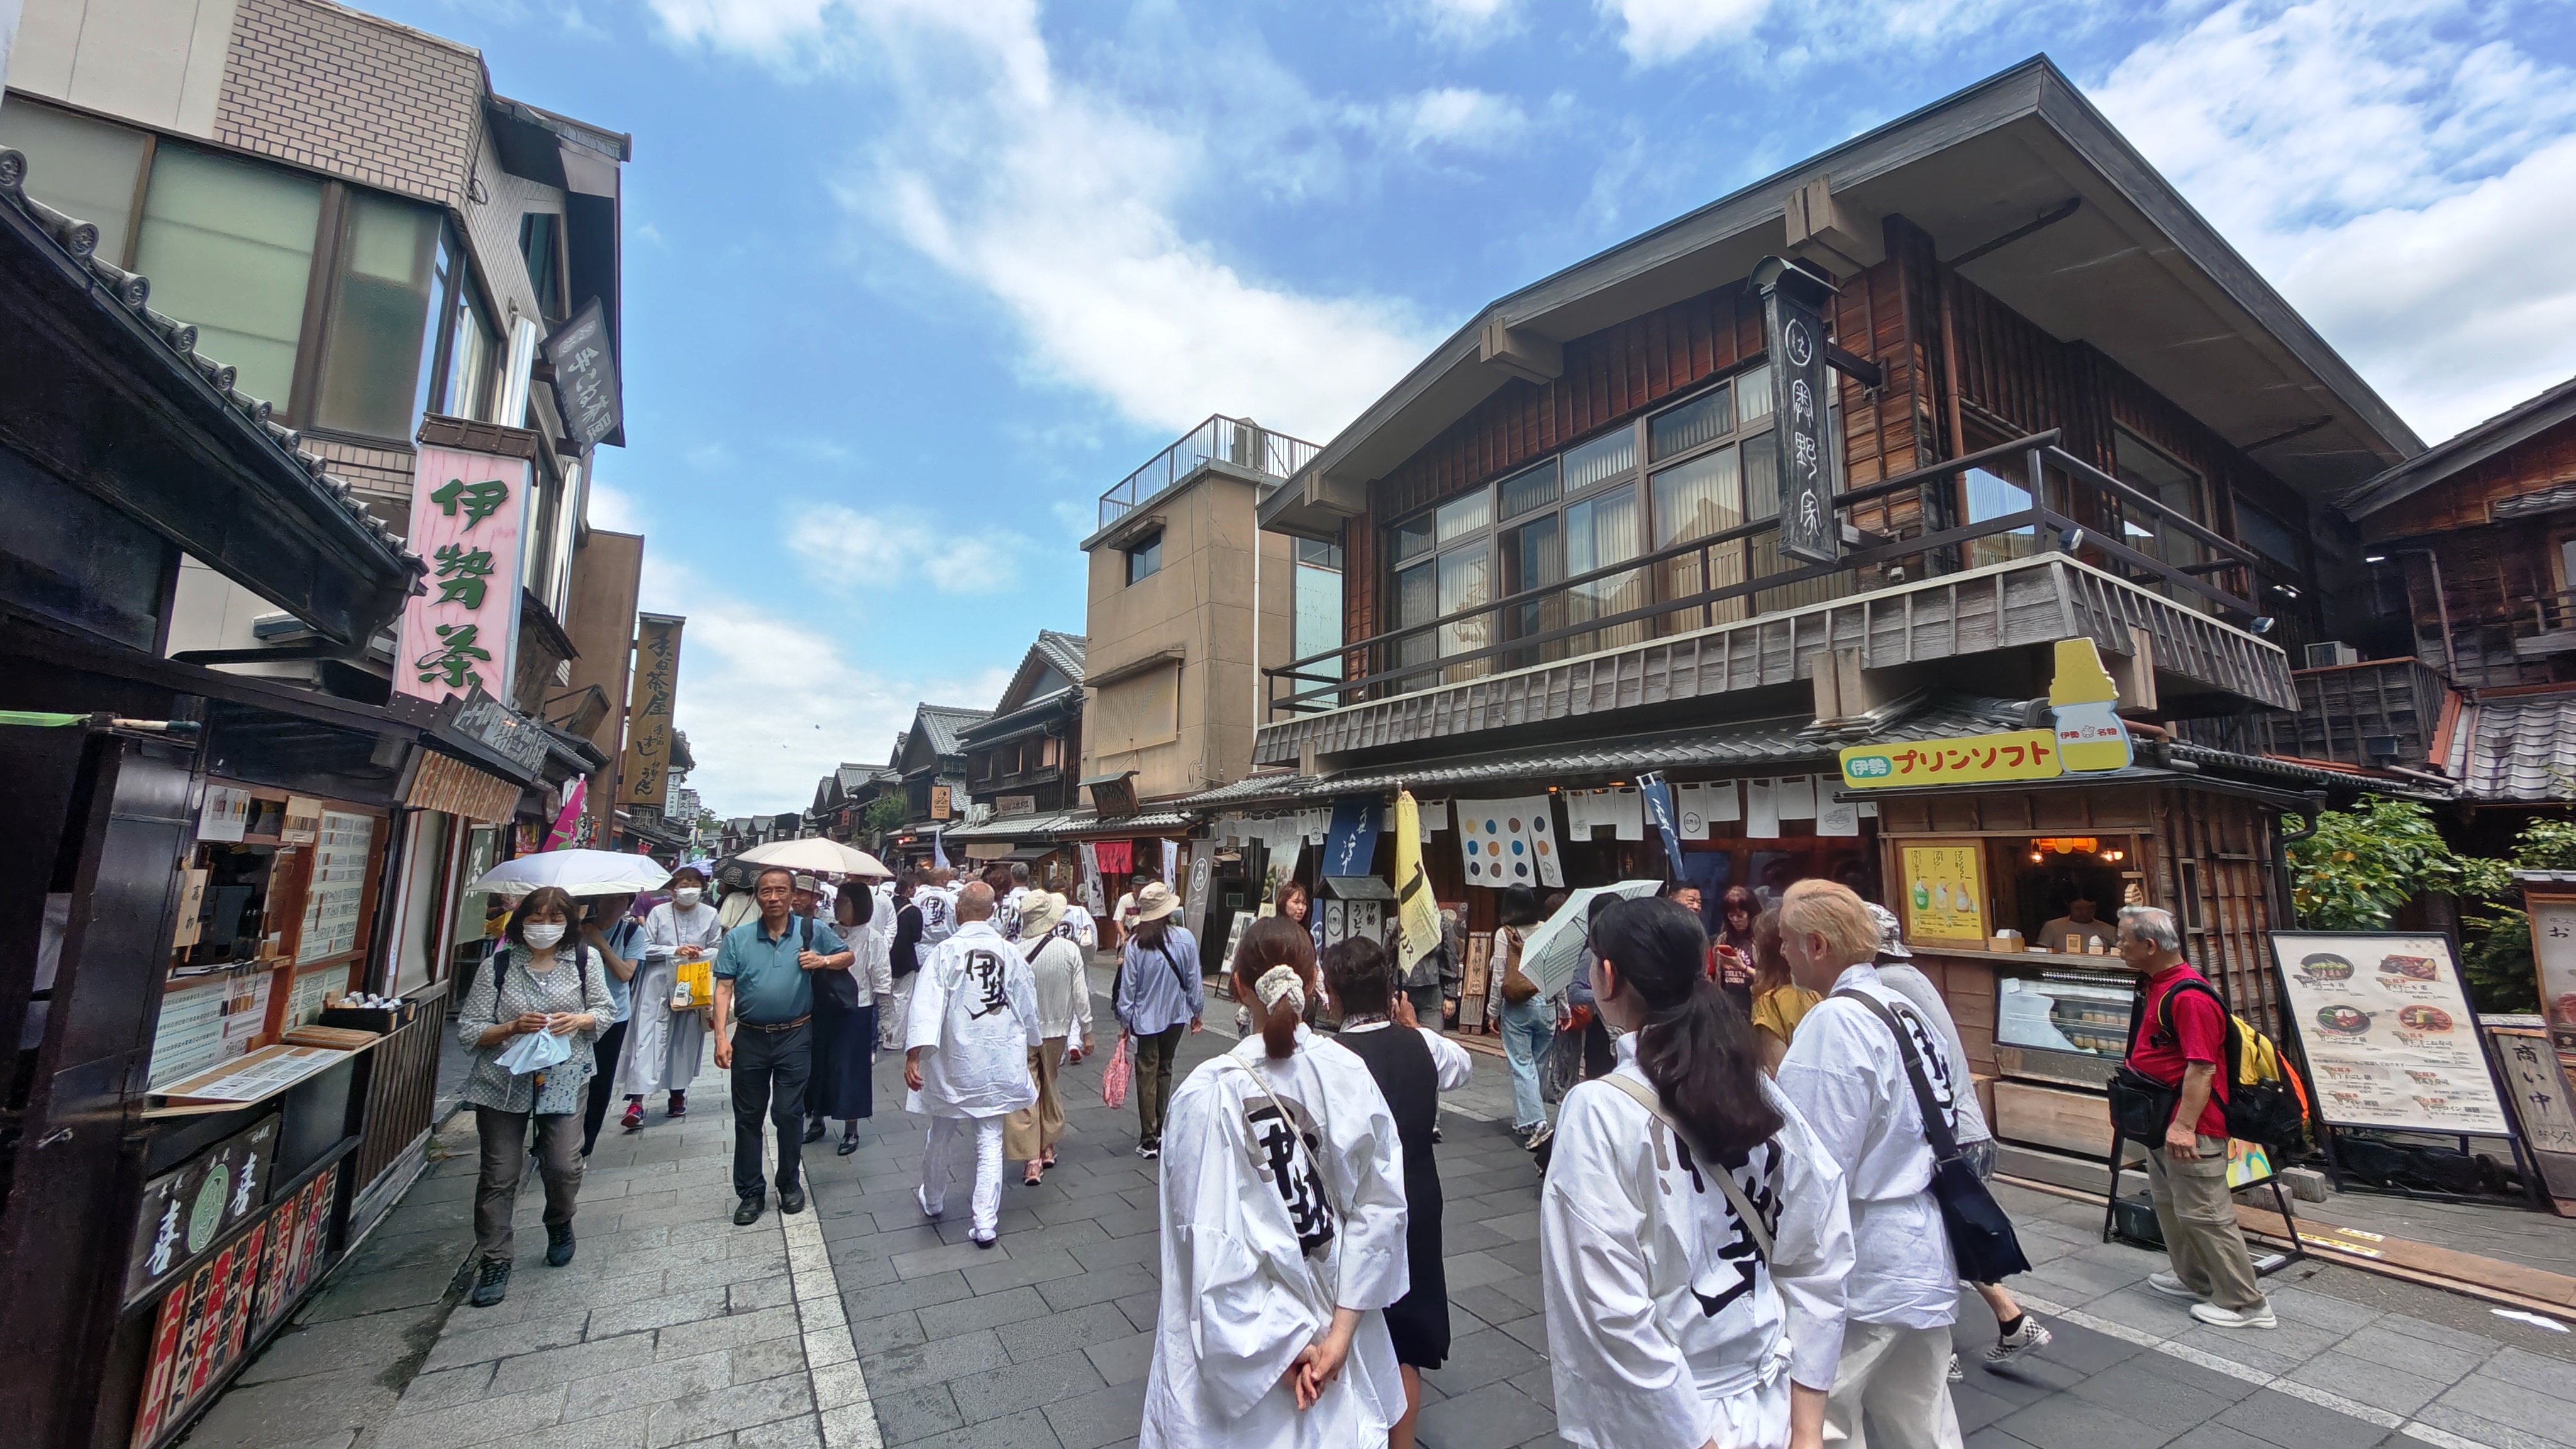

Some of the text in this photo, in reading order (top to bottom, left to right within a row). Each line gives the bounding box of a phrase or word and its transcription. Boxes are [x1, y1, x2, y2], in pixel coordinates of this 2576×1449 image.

[567, 346, 613, 443] 手こね茶屋
[414, 477, 509, 688] 伊勢茶
[636, 630, 673, 722] 手こね茶屋
[1850, 740, 2051, 776] 伊勢 プリンソフト
[2060, 728, 2117, 740] 伊勢 名物
[1366, 902, 1377, 926] 伊勢
